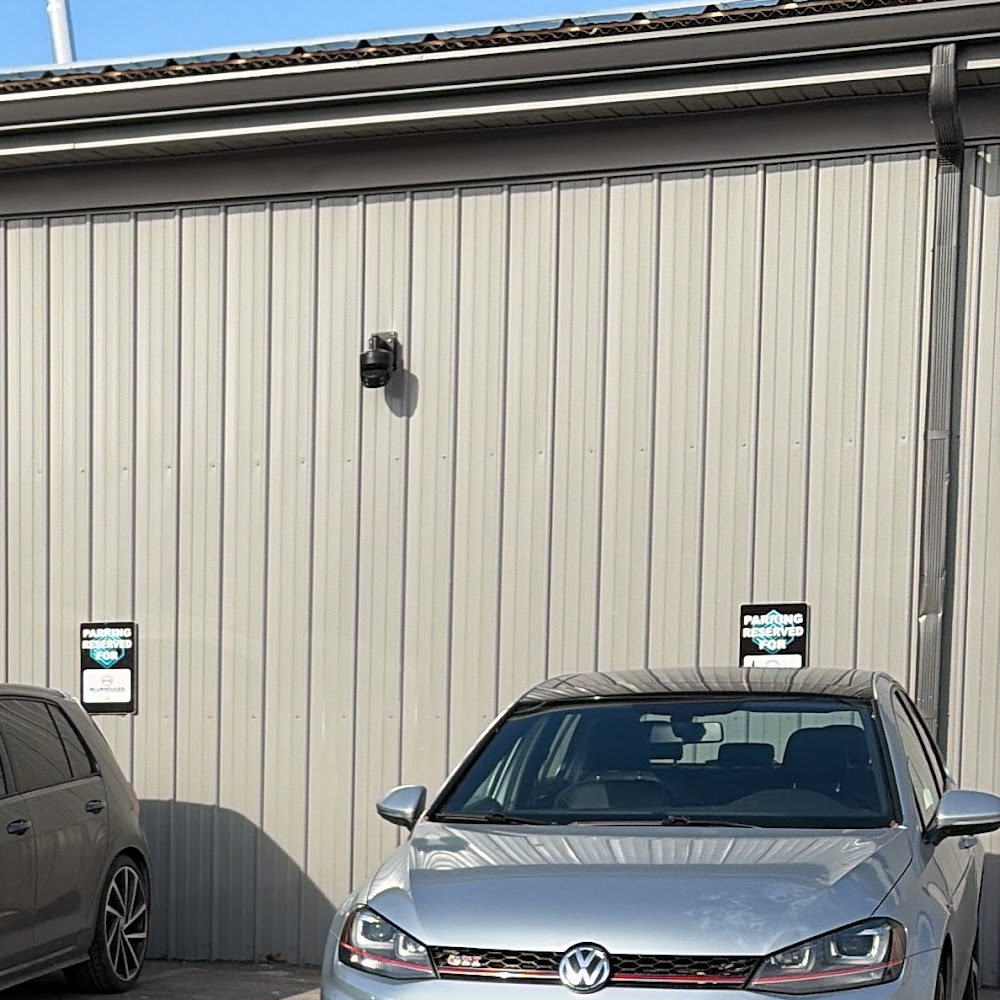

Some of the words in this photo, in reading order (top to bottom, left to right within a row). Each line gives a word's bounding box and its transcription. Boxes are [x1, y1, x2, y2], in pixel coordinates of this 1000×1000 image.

[743, 613, 804, 626] PARKING
[82, 628, 132, 638] PARKING
[742, 626, 804, 638] RESERVED
[82, 639, 132, 649] RESERVED
[759, 639, 787, 650] FOR
